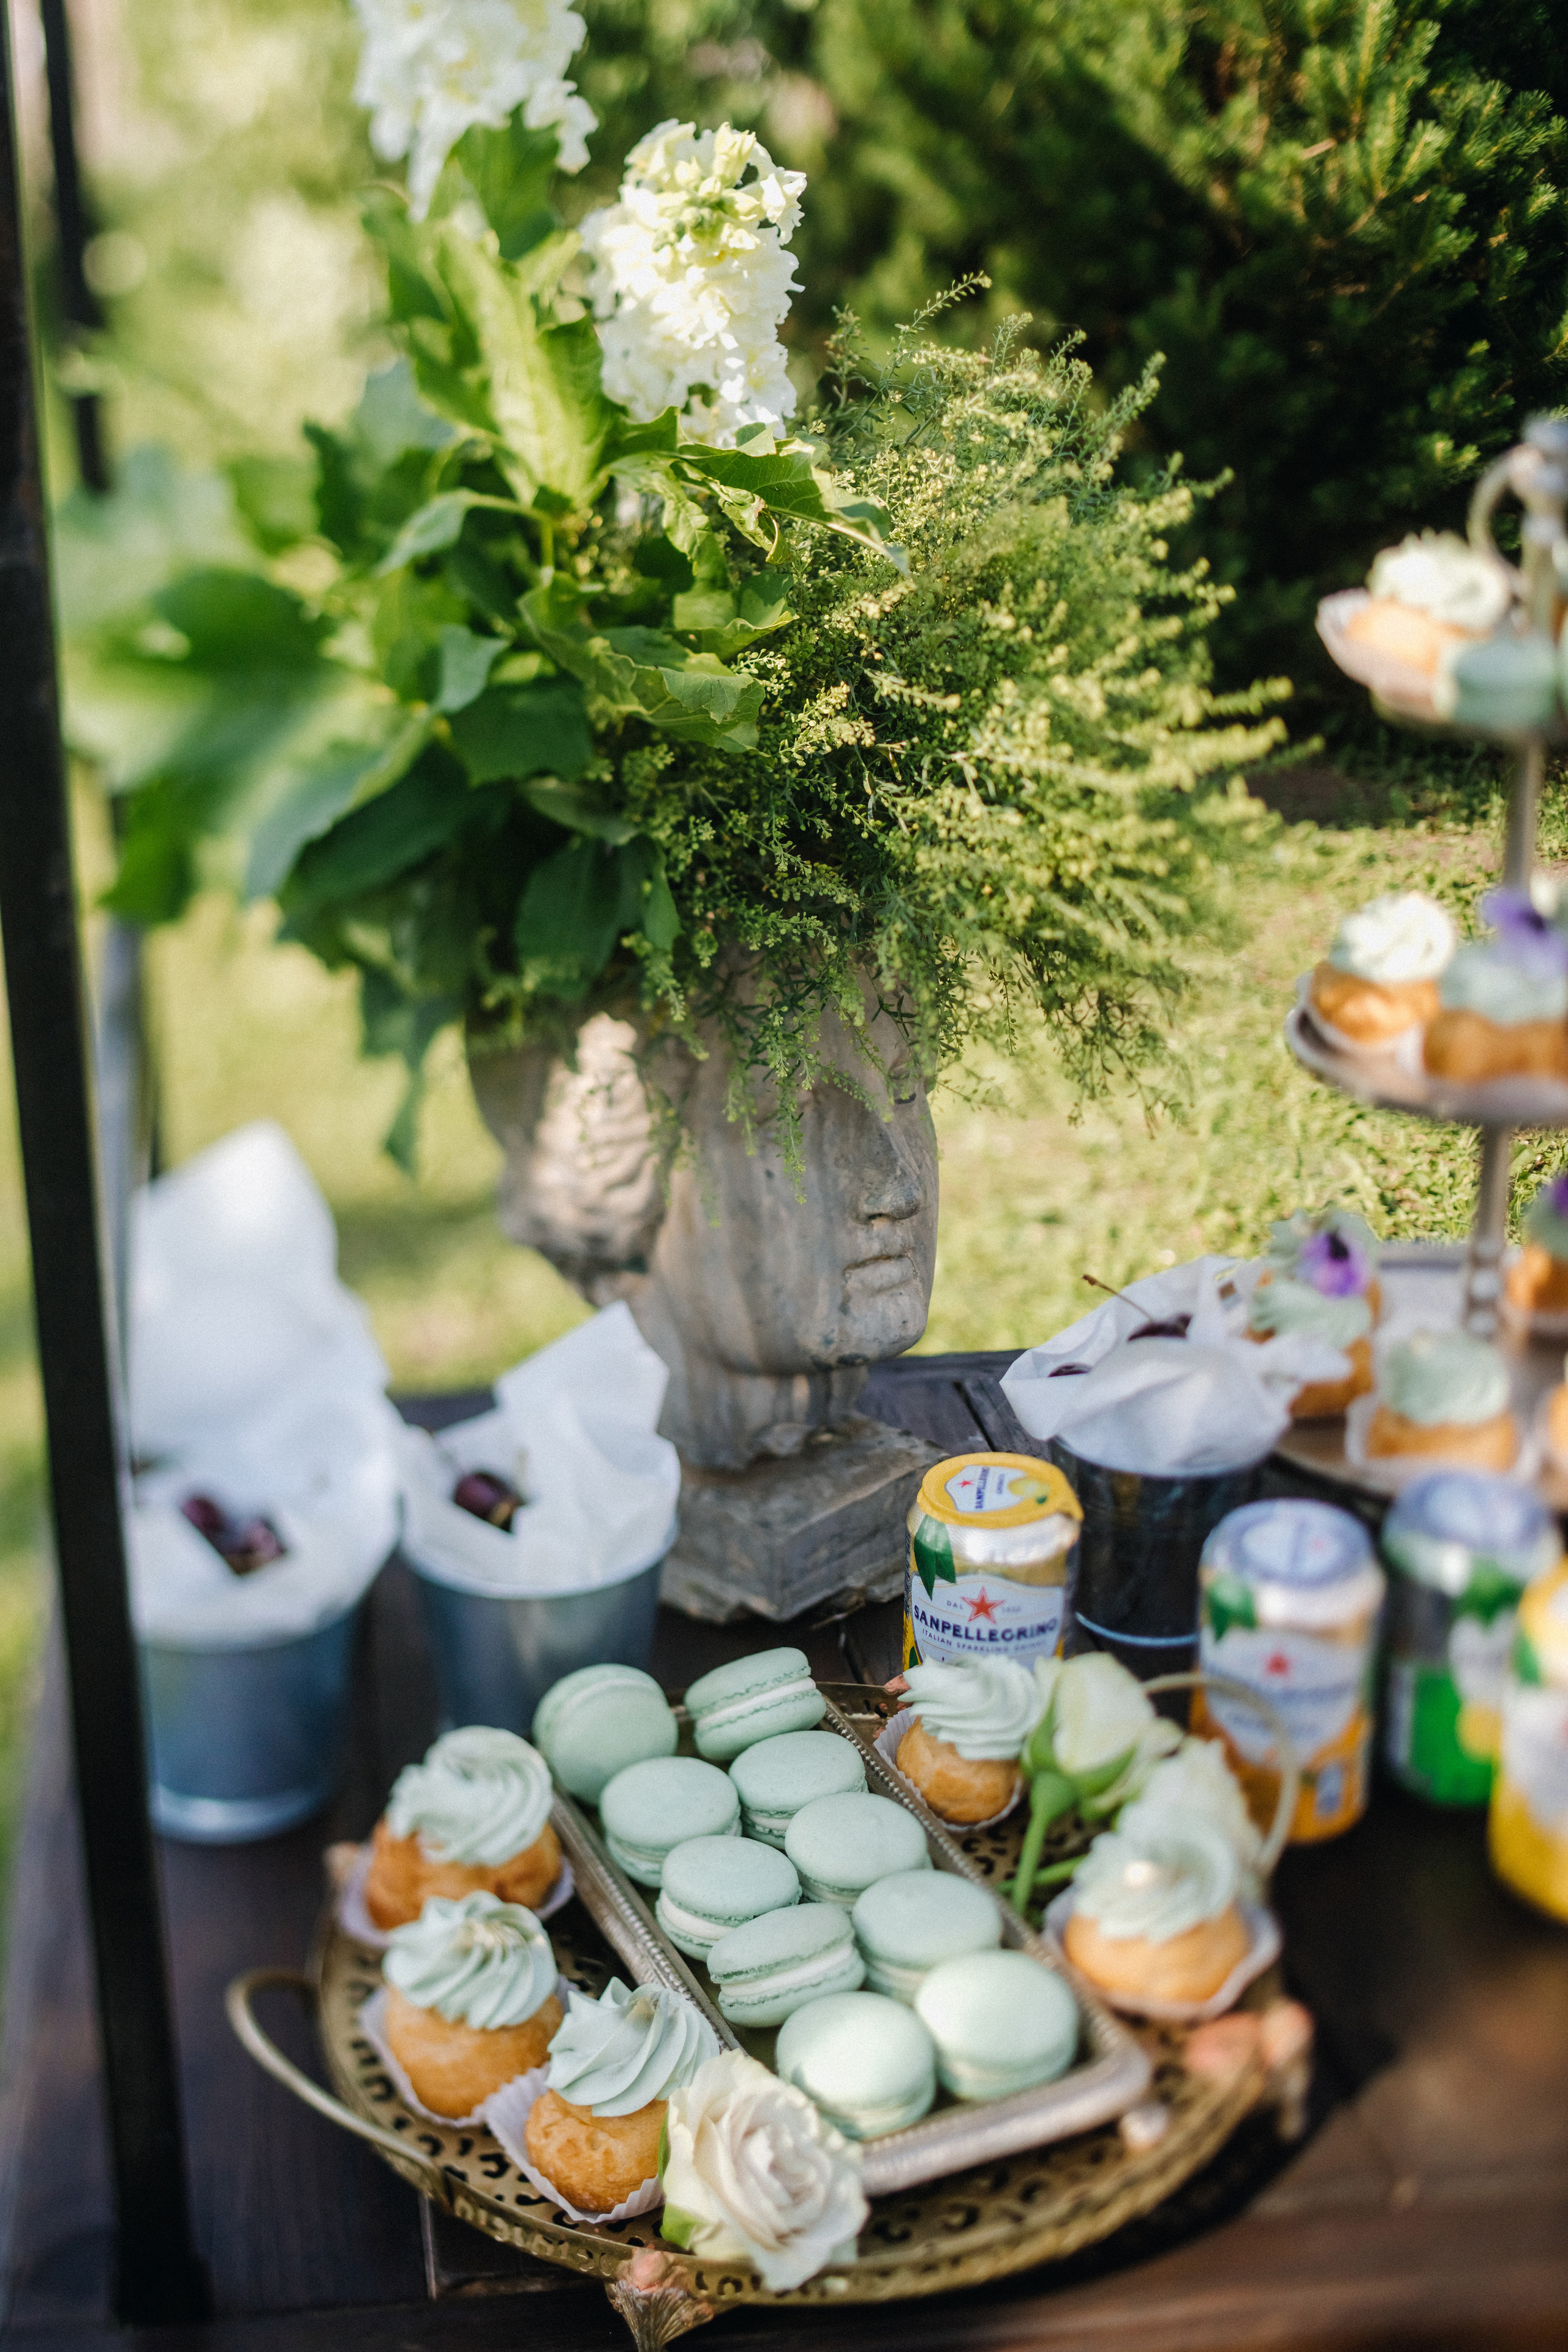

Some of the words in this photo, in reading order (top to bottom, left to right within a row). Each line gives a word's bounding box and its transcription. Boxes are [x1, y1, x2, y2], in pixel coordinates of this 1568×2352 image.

[946, 1600, 963, 1610] DAL
[914, 1604, 1057, 1642] SANPELLEGRINO
[922, 1628, 952, 1646] ITALIAN
[956, 1642, 1009, 1653] SPARKLING
